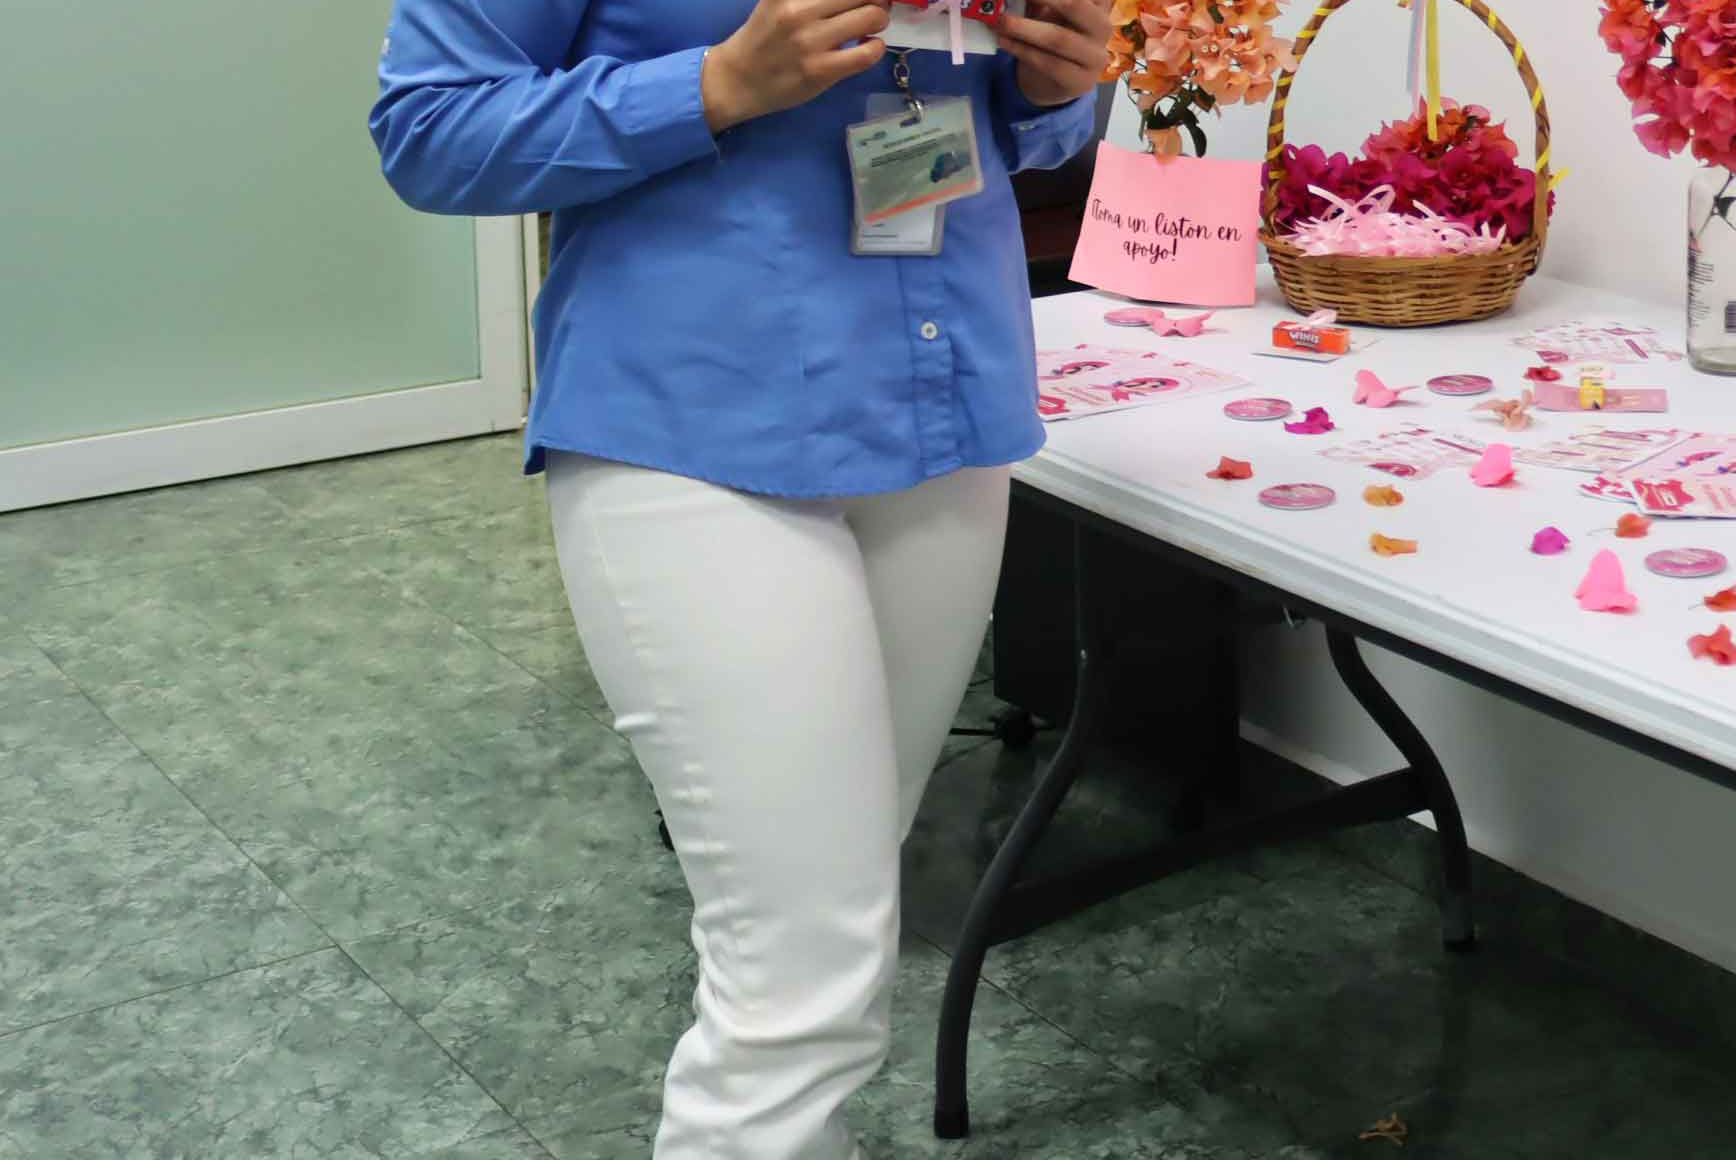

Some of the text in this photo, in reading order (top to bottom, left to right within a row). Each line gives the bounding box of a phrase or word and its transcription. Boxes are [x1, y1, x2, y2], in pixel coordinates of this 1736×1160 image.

[1128, 216, 1148, 233] un
[1155, 213, 1212, 240] liston
[1217, 225, 1242, 242] en
[1123, 238, 1177, 264] apoyo!
